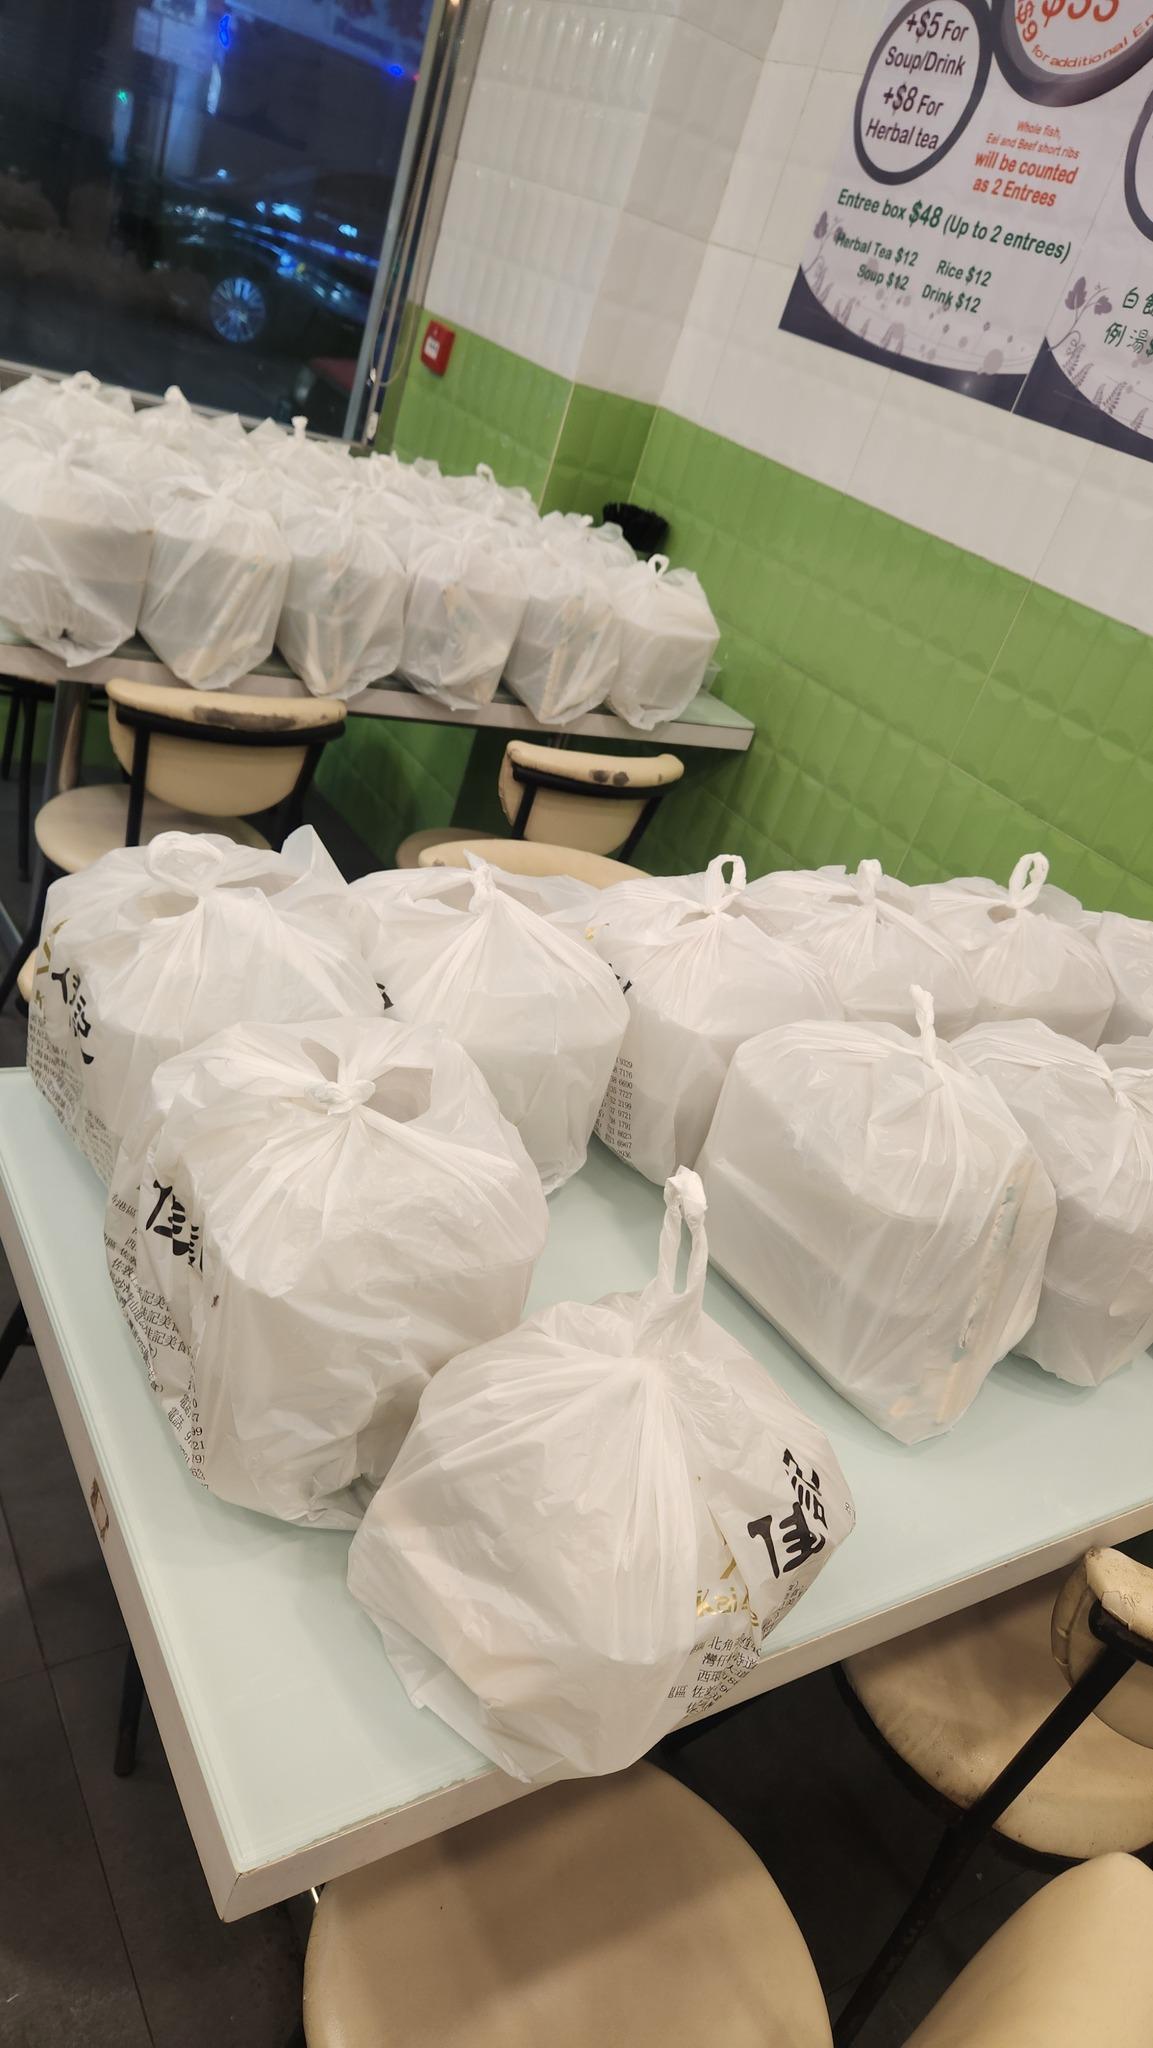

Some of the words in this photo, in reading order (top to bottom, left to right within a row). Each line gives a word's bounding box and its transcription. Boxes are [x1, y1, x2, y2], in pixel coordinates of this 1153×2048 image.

[906, 9, 943, 43] +$5
[941, 19, 969, 42] For
[885, 46, 966, 76] Soup/Drink
[883, 83, 919, 116] +$8
[917, 94, 944, 117] For
[865, 118, 916, 145] Herbal
[914, 128, 939, 150] tea
[975, 150, 1000, 169] will
[999, 153, 1017, 173] be
[1018, 162, 1080, 185] counted
[972, 178, 990, 193] as
[991, 178, 1003, 196] 2
[1003, 180, 1058, 208] Entrees
[838, 188, 880, 214] Entree
[882, 198, 908, 221] box
[908, 199, 944, 229] $48
[942, 213, 970, 240] (Up
[972, 220, 989, 241] to
[989, 224, 1003, 244] 2
[1003, 231, 1073, 265] entrees)
[835, 231, 873, 255] Herbal
[873, 241, 893, 261] Tea
[894, 246, 919, 268] $12
[857, 263, 885, 287] Soup
[886, 271, 911, 292] $12
[936, 259, 965, 281] Rice
[965, 265, 993, 288] $12
[921, 283, 955, 307] Drink
[955, 291, 982, 314] $12
